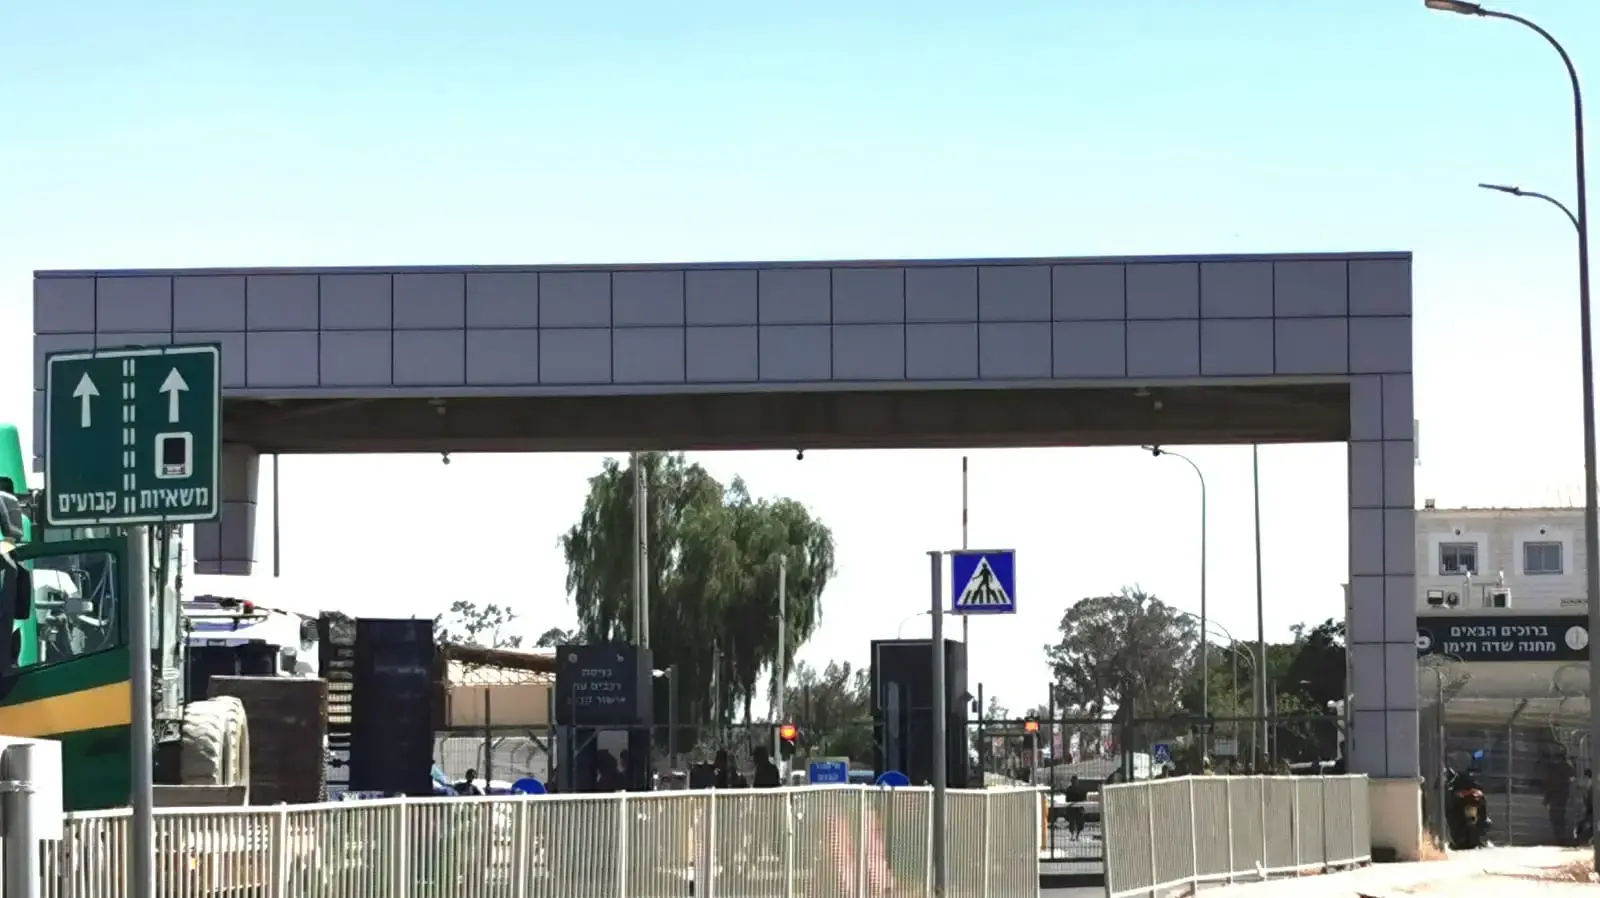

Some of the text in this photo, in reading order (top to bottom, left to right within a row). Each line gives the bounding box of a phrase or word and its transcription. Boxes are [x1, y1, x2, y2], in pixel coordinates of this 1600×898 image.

[58, 491, 117, 514] קבועים
[139, 487, 208, 509] משאיות
[1450, 625, 1548, 637] ברוכים הבאים
[1443, 640, 1557, 654] מחנה שדה תימן
